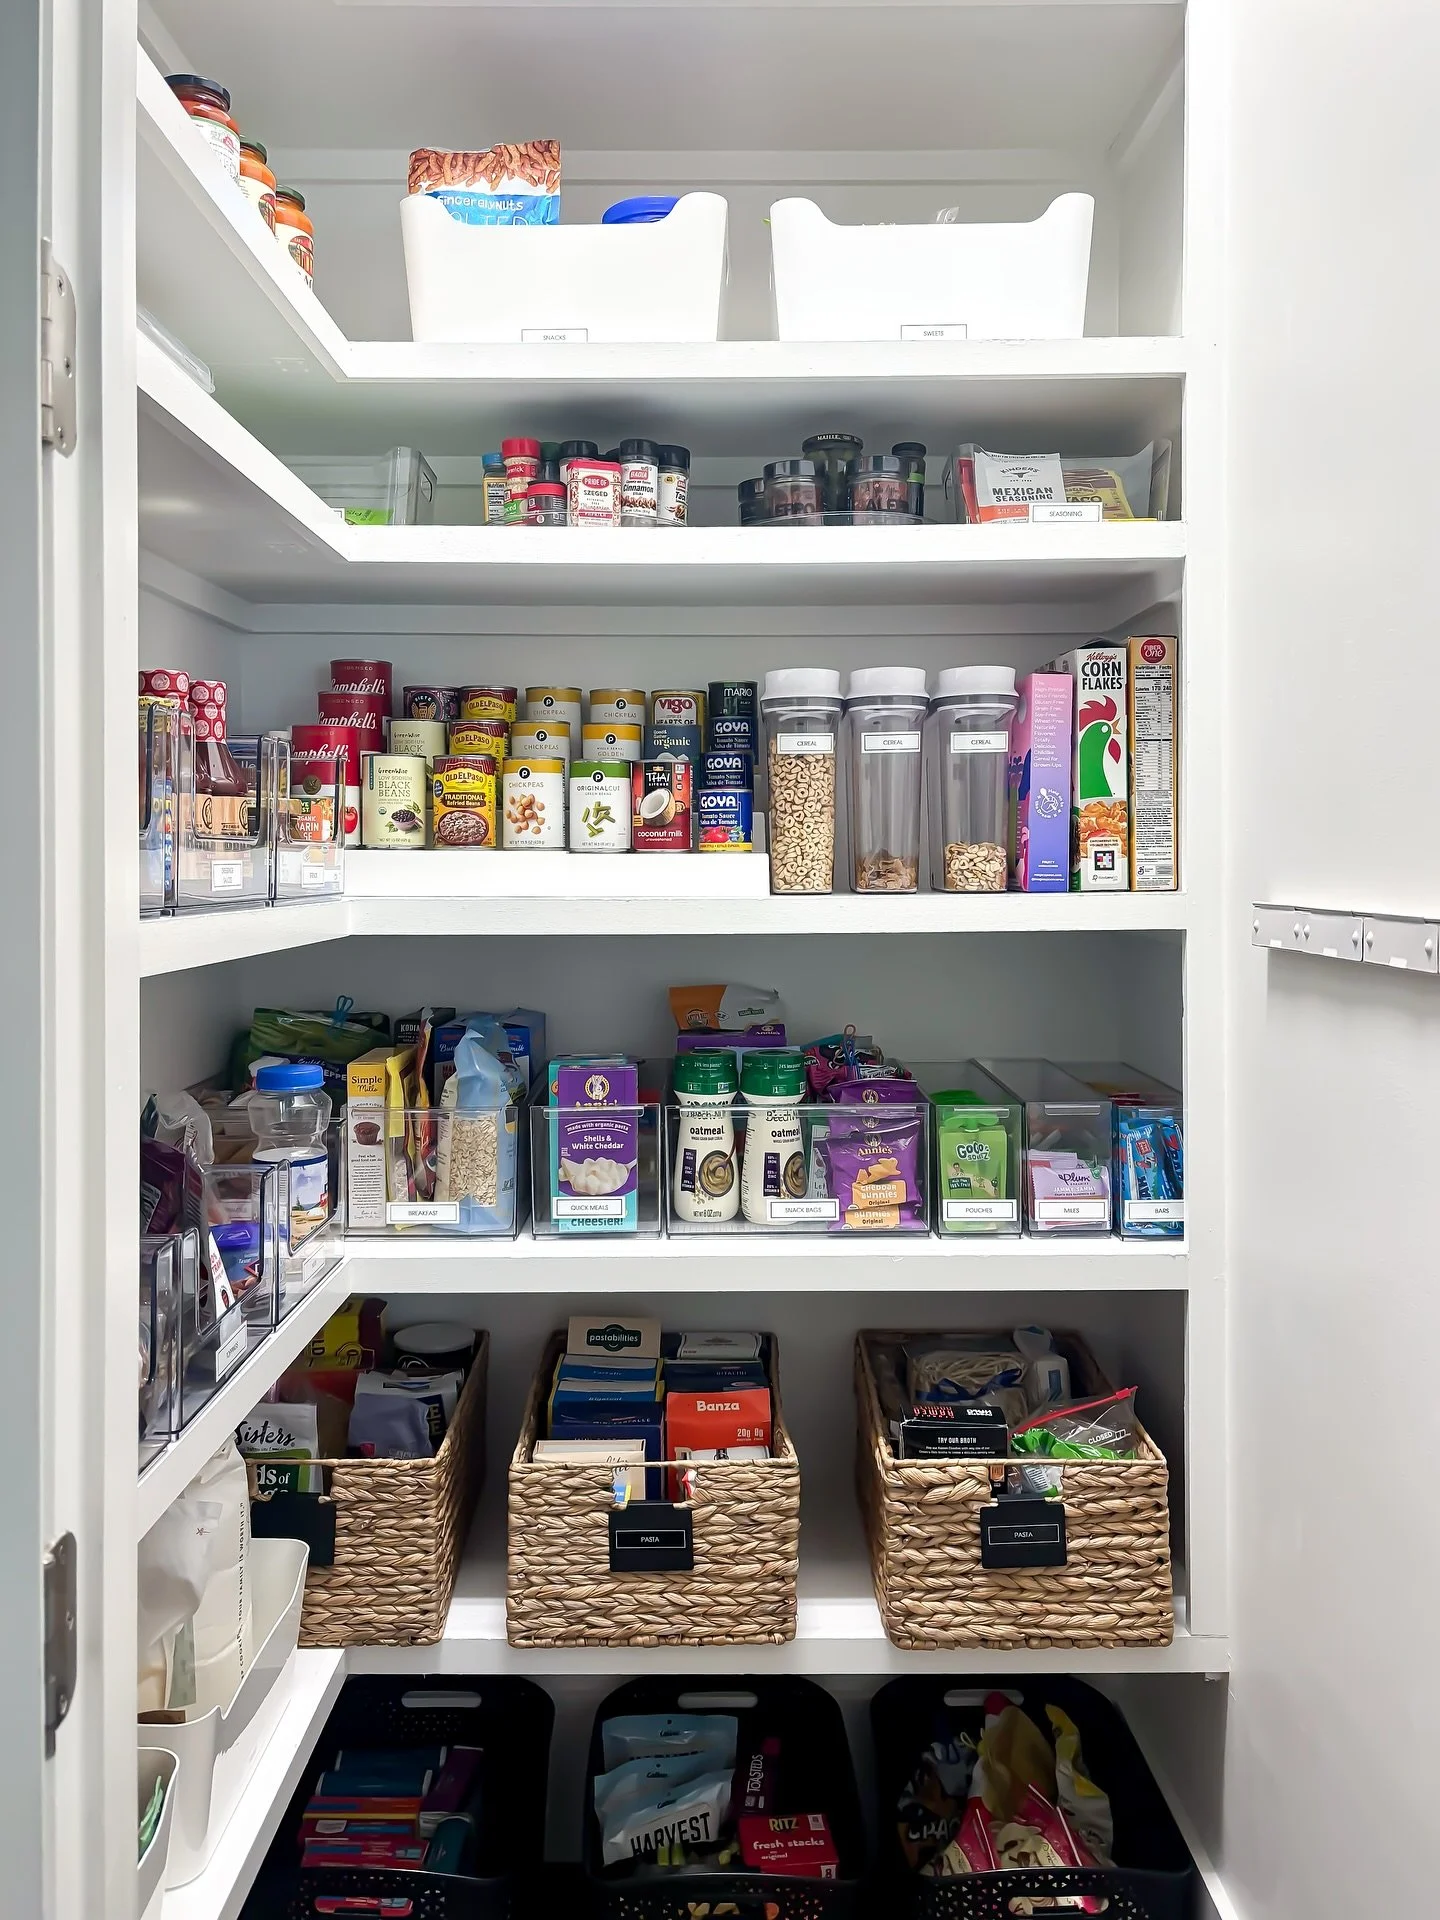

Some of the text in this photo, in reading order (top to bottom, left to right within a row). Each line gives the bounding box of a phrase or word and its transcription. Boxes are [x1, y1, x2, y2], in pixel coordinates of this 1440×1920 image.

[583, 490, 609, 498] SZEGED
[623, 484, 654, 494] Cinnamon
[992, 487, 1053, 496] MEXICAN
[995, 494, 1053, 503] SEASONING
[1086, 652, 1117, 664] Kellogg's
[1081, 661, 1122, 677] CORN
[1082, 677, 1122, 690] FLAKES
[724, 687, 753, 697] MARIO
[468, 701, 480, 710] OLD
[318, 711, 378, 731] Campbell's
[715, 721, 749, 734] GOYA
[653, 736, 691, 749] organic
[394, 745, 424, 753] BLACK
[707, 757, 742, 769] GOYA
[445, 774, 458, 783] OLD
[458, 771, 467, 780] EL
[646, 772, 670, 783] THAI
[378, 781, 411, 789] BLACK
[378, 789, 411, 798] BEANS
[444, 793, 484, 801] TRADITIONAL
[701, 796, 736, 808] GOYA
[668, 829, 683, 837] milk
[351, 1075, 383, 1085] Simple
[595, 1122, 614, 1130] organic
[690, 1125, 725, 1135] oatmeal
[858, 1145, 893, 1157] Annie's
[1062, 1172, 1091, 1186] Plum
[589, 1333, 639, 1344] pastabilities
[696, 1400, 740, 1412] Banza
[234, 1420, 296, 1447] Sisters
[1088, 1430, 1114, 1446] CLOSED
[278, 1472, 291, 1485] of
[640, 1536, 660, 1544] PASTA
[769, 1817, 799, 1831] RITZ
[630, 1811, 711, 1857] HARVEST
[753, 1837, 825, 1851] fresh stacks
[761, 1852, 788, 1861] original
[824, 1869, 832, 1878] 8
